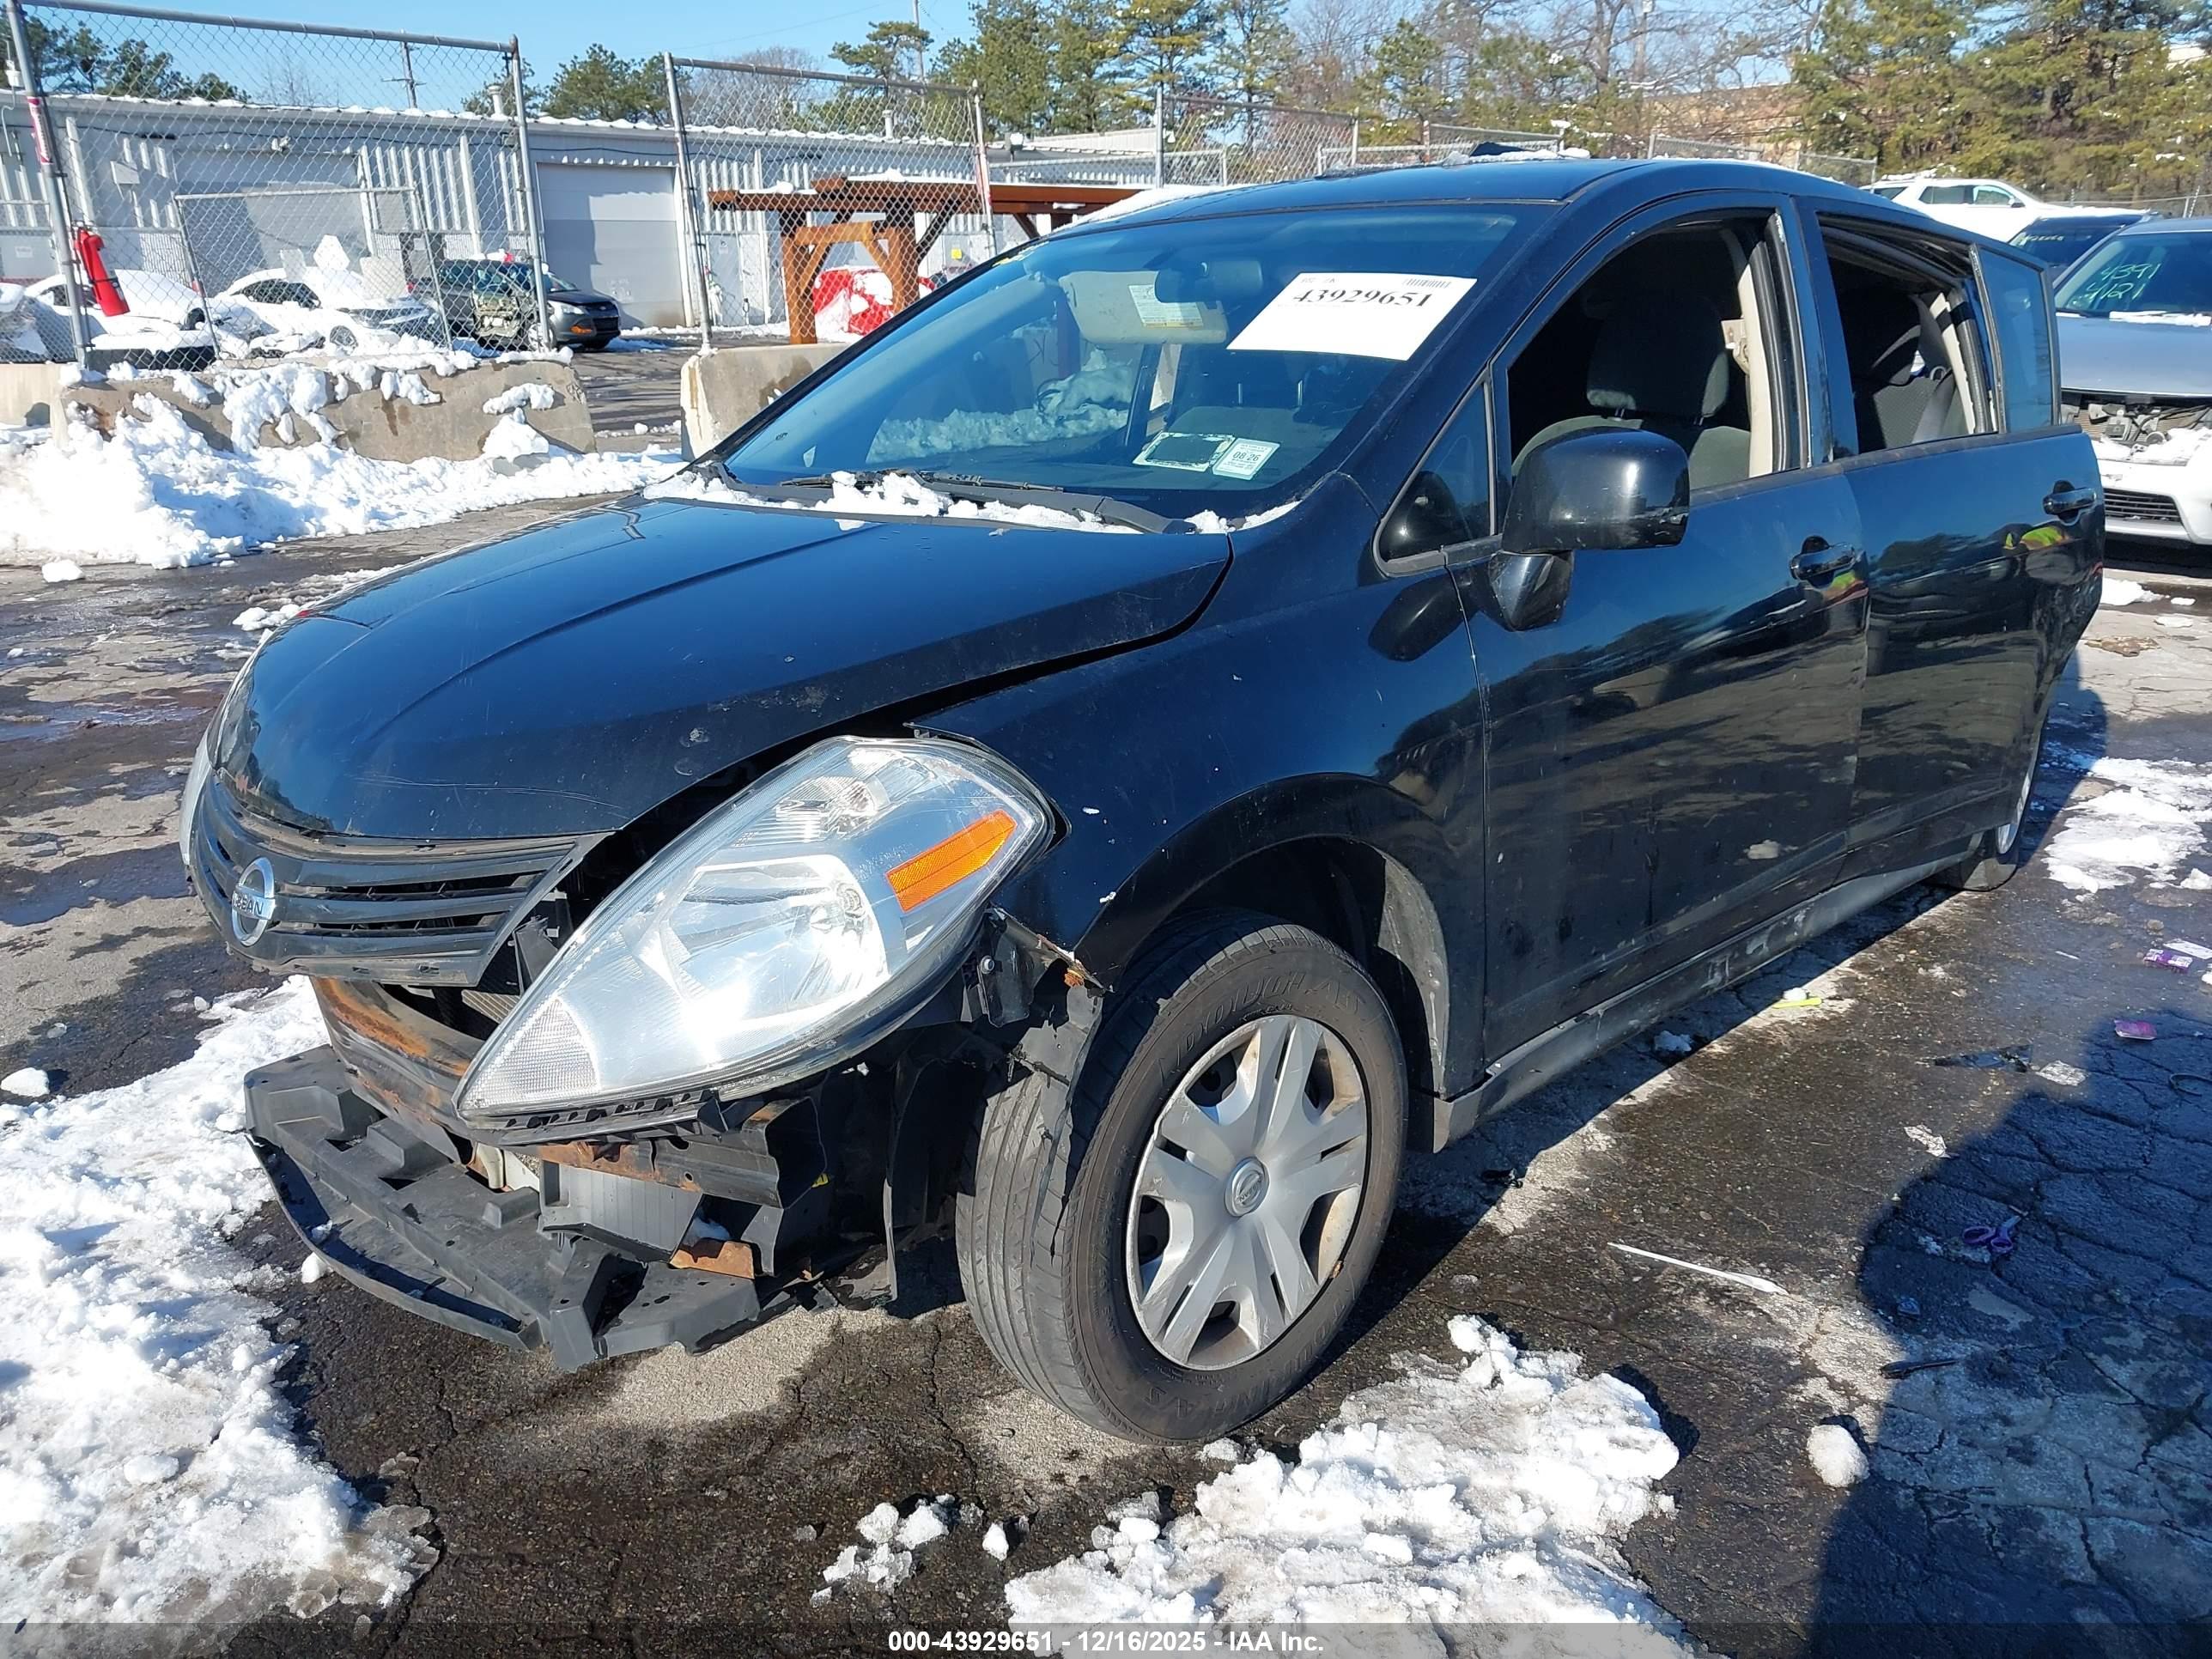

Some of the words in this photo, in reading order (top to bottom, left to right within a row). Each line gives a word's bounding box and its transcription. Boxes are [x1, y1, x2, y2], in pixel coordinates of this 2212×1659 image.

[2100, 264, 2161, 281] 4391
[1292, 289, 1432, 307] 43929651
[2087, 282, 2145, 301] 4121
